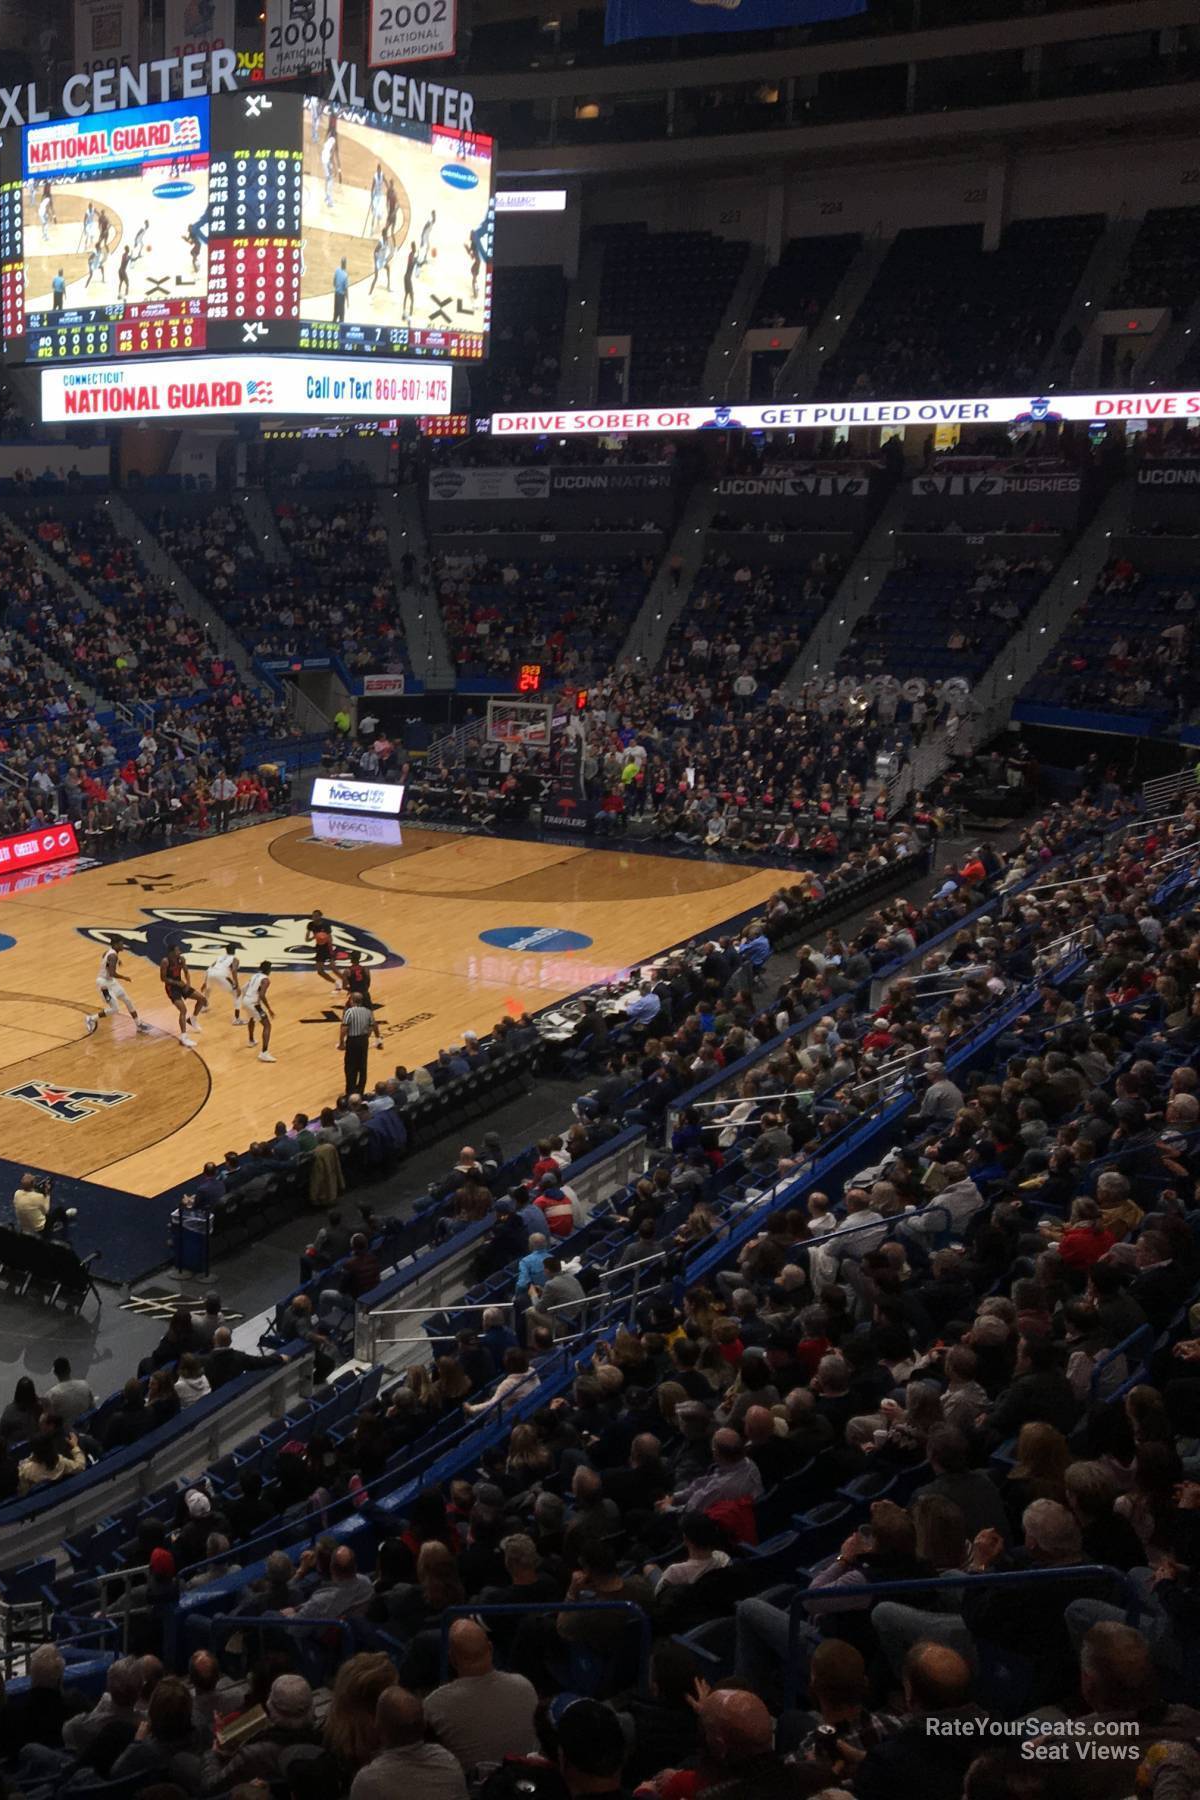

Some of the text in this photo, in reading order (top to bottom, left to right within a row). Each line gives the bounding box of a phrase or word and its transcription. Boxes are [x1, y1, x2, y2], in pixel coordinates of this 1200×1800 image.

[378, 0, 447, 31] 2002
[269, 18, 335, 49] 2000
[385, 28, 440, 45] NATIONAL
[378, 42, 445, 60] CHAMPIONS
[271, 60, 332, 76] CHAMION
[62, 47, 238, 117] CENTER
[328, 58, 475, 132] XL CENTER
[245, 94, 273, 117] XL
[30, 131, 108, 164] NATIONAL
[113, 123, 171, 151] GUARD
[255, 149, 271, 159] AST
[237, 159, 247, 172] 0
[258, 159, 267, 171] 0
[278, 160, 287, 172] 0
[237, 174, 246, 187] 0
[258, 174, 267, 186] 0
[277, 174, 286, 187] 0
[257, 189, 266, 201] 0
[277, 189, 286, 201] 0
[236, 203, 246, 216] 0
[259, 203, 265, 215] 1
[277, 203, 286, 216] 2
[237, 219, 246, 231] 2
[257, 218, 266, 230] 0
[277, 218, 286, 230] 0
[253, 238, 270, 247] AST
[236, 248, 245, 260] 6
[256, 247, 266, 259] 0
[236, 262, 245, 274] 0
[258, 262, 264, 273] 1
[276, 262, 285, 274] 0
[256, 276, 266, 288] 0
[275, 276, 284, 288] 0
[235, 290, 245, 303] 0
[256, 290, 265, 302] 0
[275, 290, 284, 302] 0
[89, 312, 96, 322] 7
[130, 307, 139, 317] 11
[235, 305, 245, 317] 0
[256, 305, 265, 317] 0
[275, 305, 284, 317] 0
[59, 335, 66, 346] 0
[73, 334, 80, 344] 0
[87, 333, 94, 344] 0
[100, 332, 107, 342] 0
[141, 329, 148, 339] 6
[155, 328, 162, 338] 0
[171, 326, 178, 336] 3
[185, 325, 192, 336] 0
[242, 321, 269, 343] XL
[375, 328, 381, 341] 7
[414, 332, 422, 343] 11
[59, 346, 67, 356] 0
[72, 345, 80, 355] 0
[87, 344, 94, 354] 0
[100, 343, 107, 353] 0
[141, 340, 148, 350] 0
[157, 339, 161, 349] 1
[170, 338, 178, 348] 0
[184, 337, 192, 347] 0
[63, 372, 125, 386] CONNECTICUT
[306, 375, 448, 402] Call or Text 860-607-1475
[65, 380, 243, 413] NATIONAL GUARD
[760, 403, 990, 424] GET PULLED OVER
[1095, 398, 1178, 415] DRIVE
[497, 412, 691, 431] DRIVE SOBER OR
[553, 476, 608, 489] UCONN
[1137, 468, 1200, 485] UCONN
[717, 477, 785, 495] UCONN
[1003, 477, 1081, 492] HUSKIES
[366, 680, 402, 691] ESPN
[520, 674, 539, 690] 24
[329, 785, 370, 802] tweed
[544, 814, 587, 828] TRAVELERS
